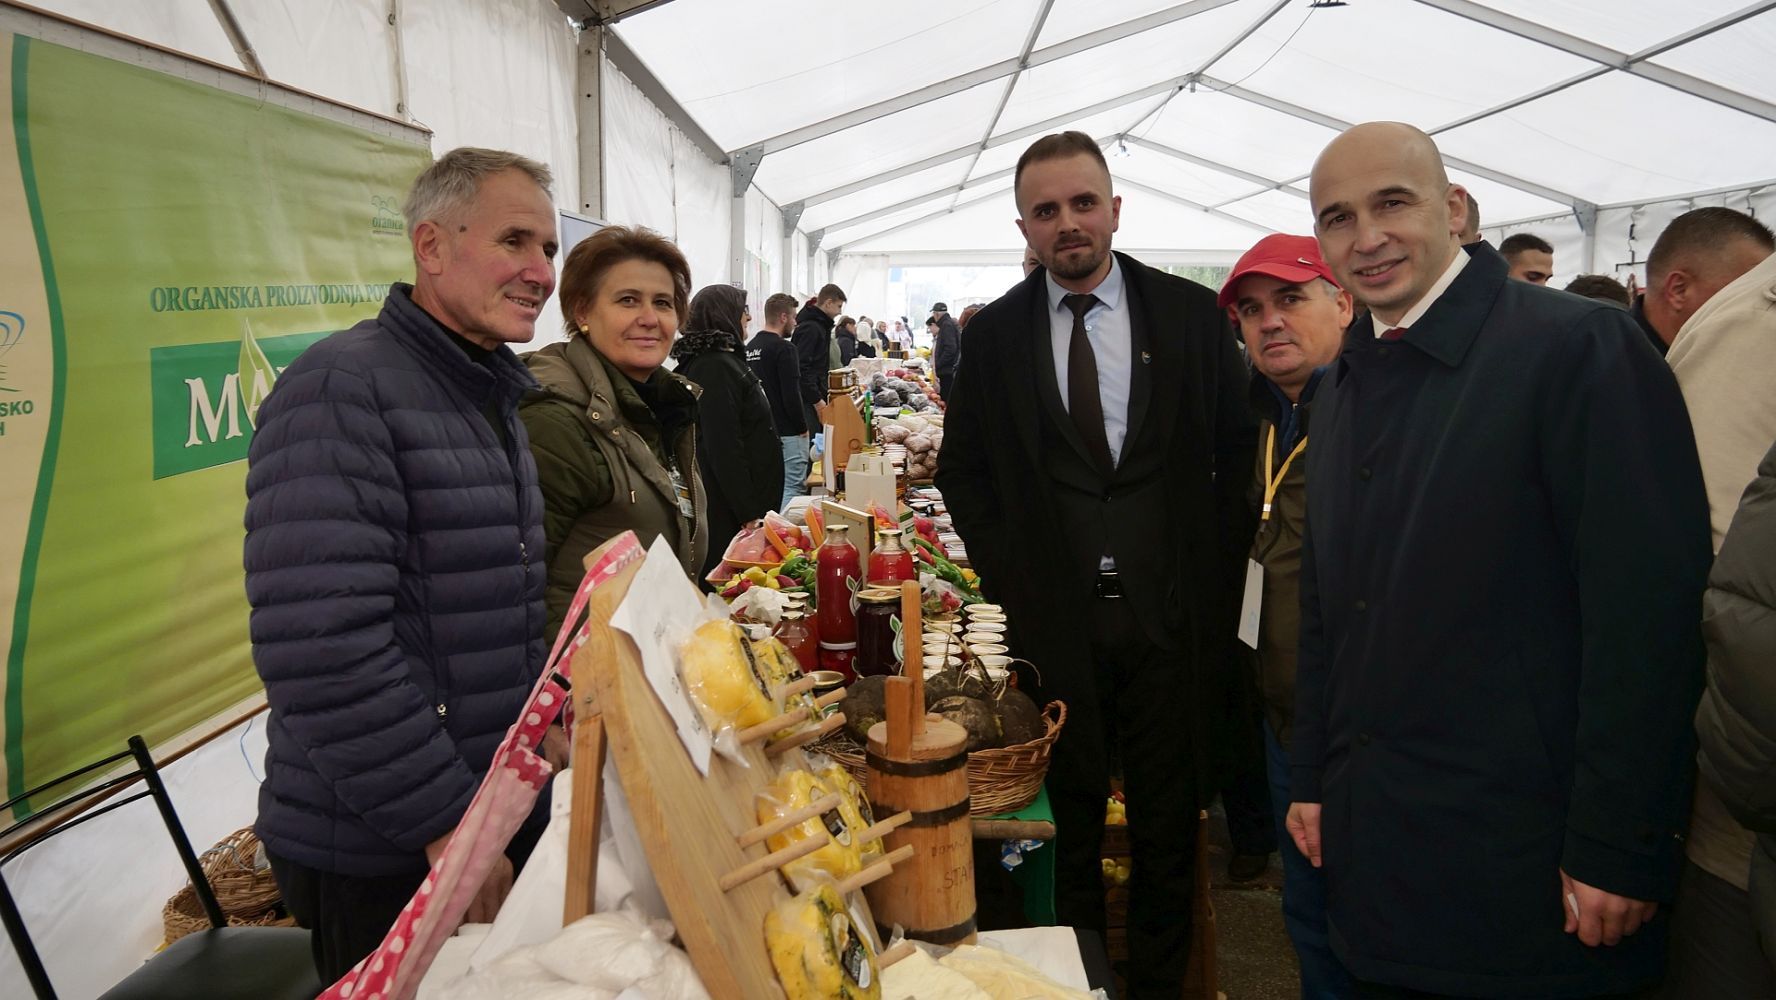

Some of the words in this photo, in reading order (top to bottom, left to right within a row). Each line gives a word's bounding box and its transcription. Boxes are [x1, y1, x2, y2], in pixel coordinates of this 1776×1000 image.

[150, 285, 264, 313] ORGANSKA
[265, 283, 365, 307] PROIZVODNJA
[365, 283, 392, 302] POV
[184, 366, 288, 448] MA
